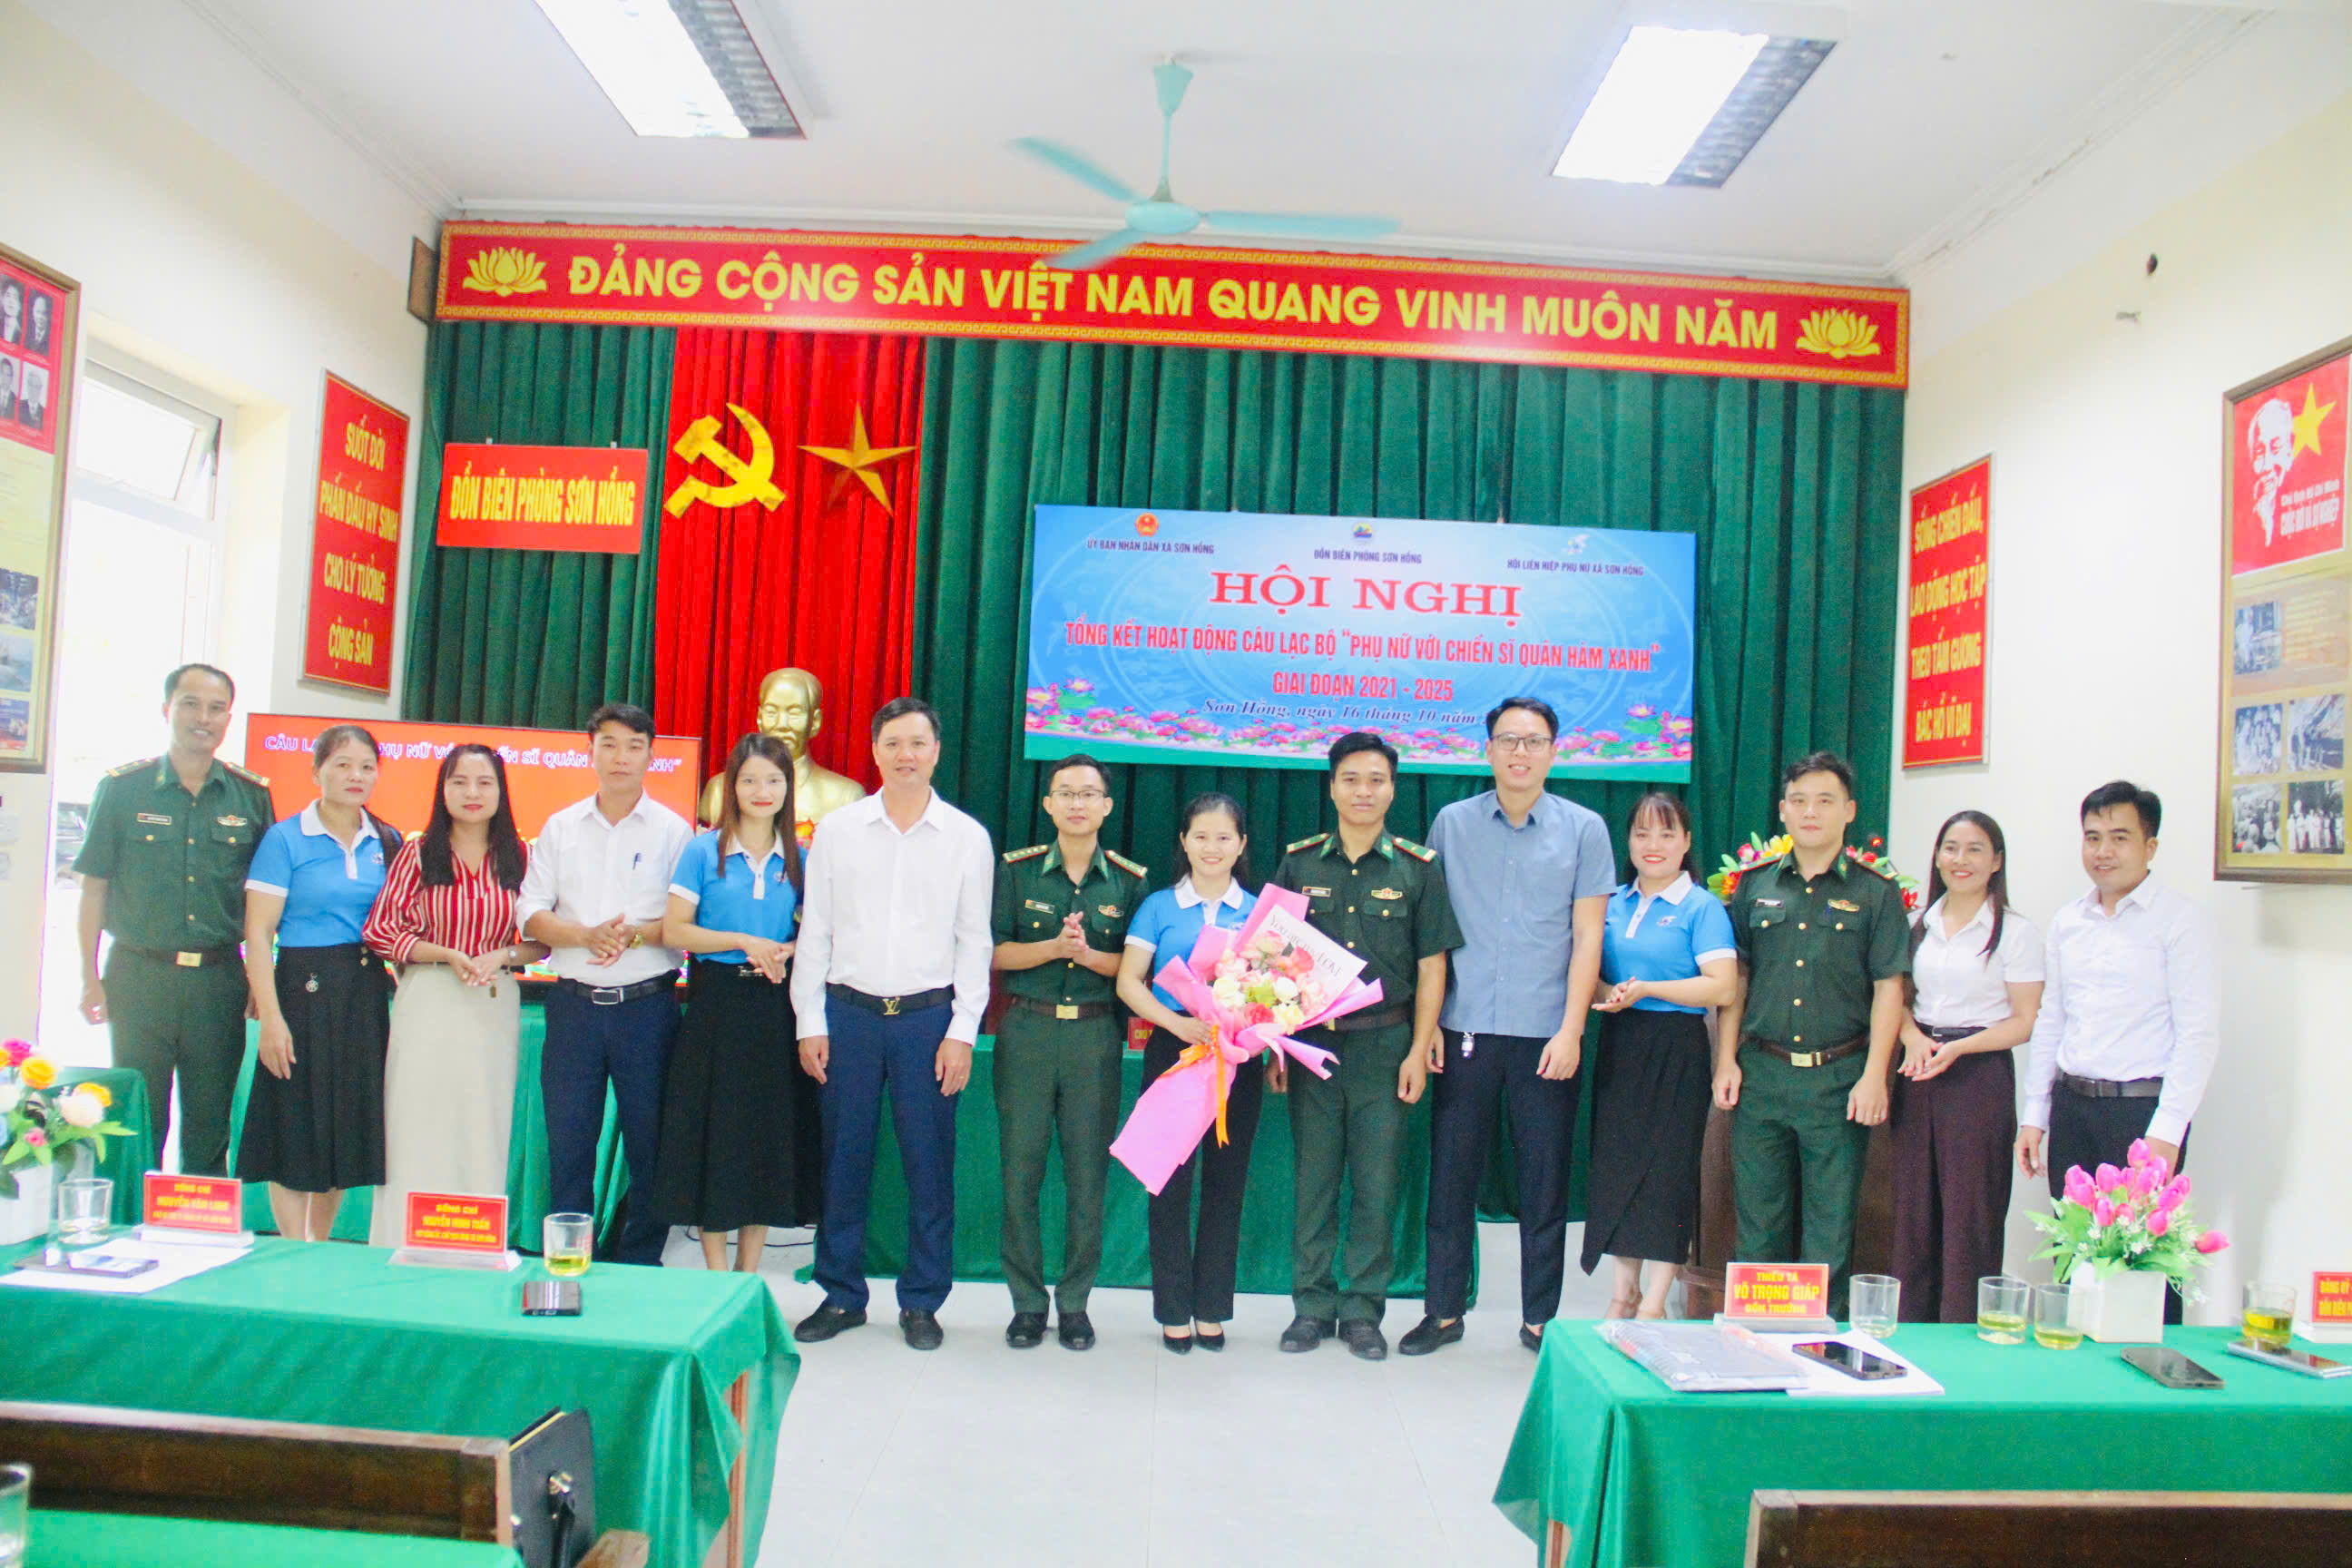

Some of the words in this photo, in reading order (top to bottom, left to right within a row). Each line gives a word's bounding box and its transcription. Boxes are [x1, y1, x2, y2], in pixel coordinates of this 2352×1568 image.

[568, 242, 702, 298] ĐẢNG
[716, 250, 859, 312] CỘNG
[872, 252, 965, 307] SẢN
[980, 260, 1073, 321] VIỆT
[1087, 274, 1193, 317] NAM
[1208, 279, 1380, 326] QUANG
[1395, 288, 1506, 333] VINH
[1522, 289, 1660, 344] MUÔN
[1675, 298, 1777, 350] NĂM
[449, 460, 481, 521] ĐỒN
[481, 466, 515, 522] BIÊN
[515, 466, 564, 524] PHÒNG
[564, 475, 595, 524] SƠN
[595, 466, 636, 526] HỒNG
[1210, 564, 1331, 615] HỘI
[1352, 577, 1523, 627] NGHỊ
[1065, 613, 1108, 646] TỔNG
[1112, 618, 1142, 647] KẾT
[1147, 626, 1189, 653] HOẠT
[1192, 624, 1237, 655] ĐỘNG
[1242, 625, 1275, 653] CÂU
[1279, 632, 1309, 659] LẠC
[1315, 629, 1336, 661] BỘ
[1387, 632, 1412, 660] NỮ
[1416, 634, 1440, 662] VỚI
[1446, 633, 1494, 663] CHIẾN
[1498, 638, 1514, 665] SĨ
[1519, 640, 1563, 668] QUÂN
[1568, 642, 1602, 669] HÀM
[1273, 671, 1306, 694] GIAI
[1310, 673, 1355, 701] ĐOẠN
[1359, 676, 1396, 698] 2021
[1415, 678, 1453, 701] 2025
[1202, 699, 1235, 713] Sơn
[1241, 698, 1290, 718] Hồng,
[1297, 704, 1336, 720] ngày
[1340, 705, 1359, 719] 16
[1365, 708, 1412, 724] tháng
[1418, 709, 1436, 722] 10
[1441, 711, 1477, 725] năm
[265, 733, 298, 750] CÂU
[406, 741, 433, 759] NỮ
[522, 747, 540, 765] SĨ
[544, 749, 588, 769] QUÂN
[1734, 1281, 1749, 1300] VÕ
[1751, 1283, 1789, 1303] TRỌNG
[1792, 1282, 1820, 1300] GIÁP
